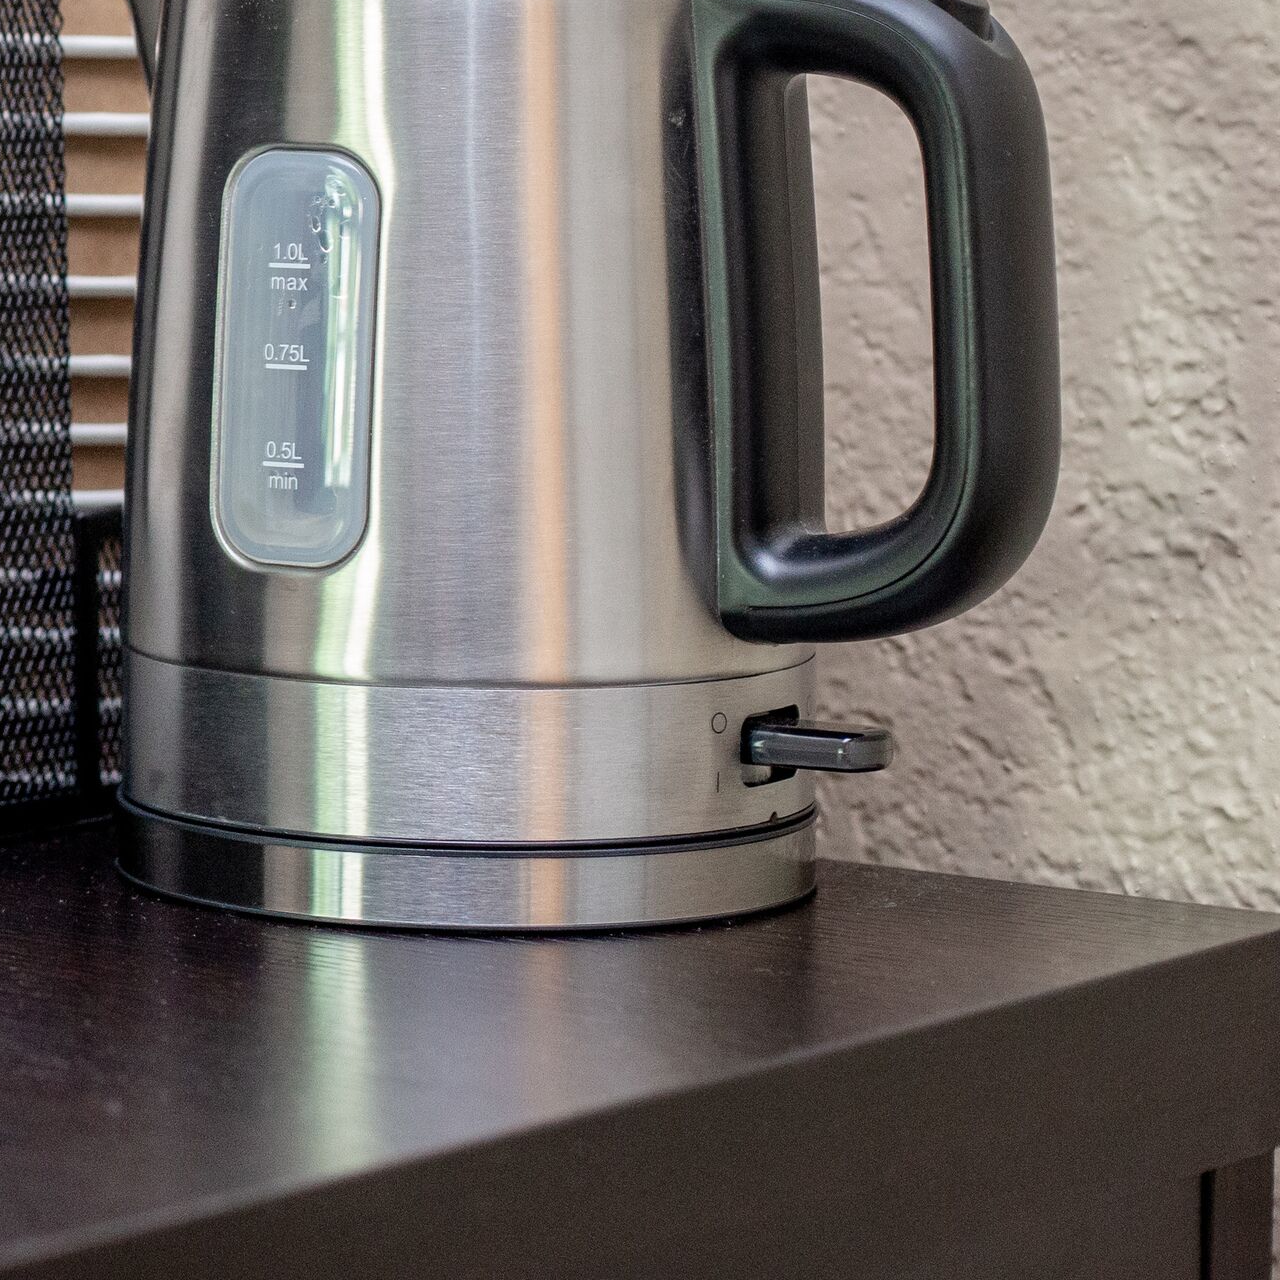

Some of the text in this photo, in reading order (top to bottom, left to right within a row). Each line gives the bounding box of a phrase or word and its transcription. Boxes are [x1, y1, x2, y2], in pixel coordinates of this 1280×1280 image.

[272, 243, 308, 261] 1.0L
[271, 276, 308, 291] max
[264, 344, 310, 362] 0.75L
[266, 442, 302, 461] 0.5L
[269, 474, 298, 490] min
